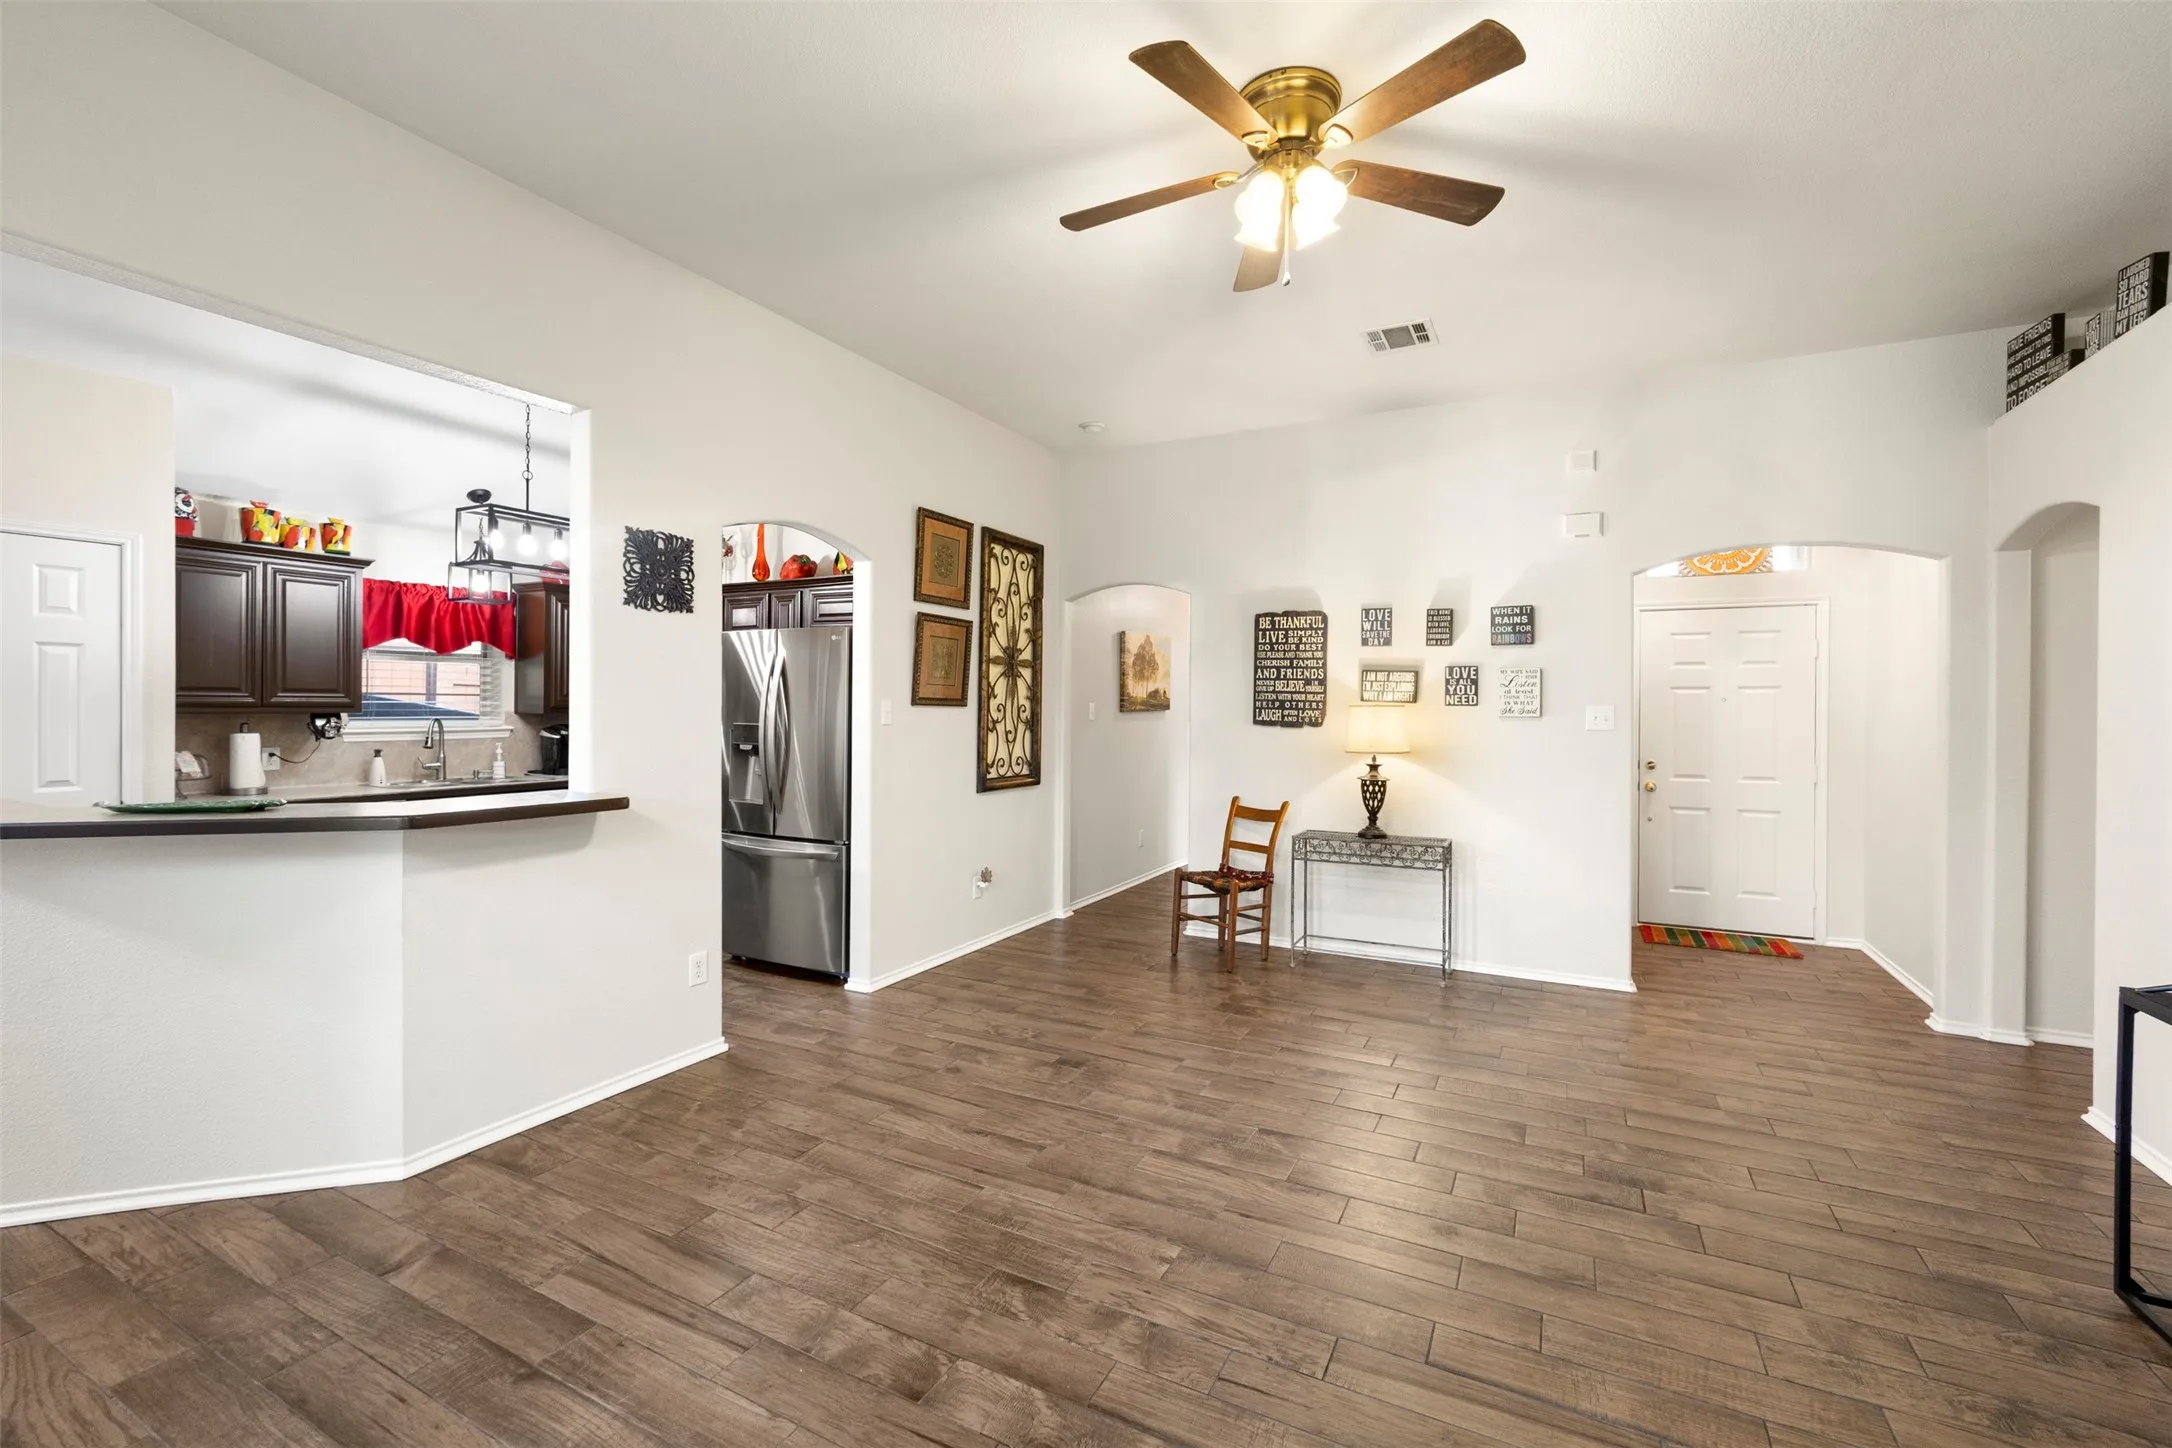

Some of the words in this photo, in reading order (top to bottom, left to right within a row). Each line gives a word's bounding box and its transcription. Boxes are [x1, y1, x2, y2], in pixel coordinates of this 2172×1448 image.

[2118, 279, 2128, 294] SO
[2129, 268, 2149, 288] HARD
[2118, 281, 2149, 310] TEARS
[2115, 318, 2128, 336] MY
[2007, 335, 2024, 354] TRUE
[2024, 317, 2052, 343] FRIENDS
[2007, 363, 2023, 379] HARD
[2023, 357, 2031, 371] TO
[2032, 345, 2051, 365] LEAVE
[2006, 395, 2017, 411] TO
[1362, 609, 1391, 620] LOVE
[1492, 606, 1520, 614] WHEN
[1259, 617, 1272, 628] BE
[1274, 616, 1324, 628] THANKFUL
[1362, 621, 1390, 630] WILL
[1495, 616, 1528, 624] RAINS
[1258, 631, 1286, 642] LIVE
[1362, 630, 1378, 638] SAVE
[1492, 634, 1532, 644] RAINBOWS
[1368, 638, 1384, 646] DAY
[1256, 668, 1277, 678] AND
[1280, 668, 1324, 679] FRIENDS
[1367, 672, 1376, 681] AM
[1377, 672, 1388, 682] NOT
[1446, 666, 1477, 679] LOVE
[1275, 680, 1305, 692] BELIEVE
[1372, 682, 1384, 691] JUST
[1447, 685, 1476, 695] YOU
[1363, 691, 1378, 700] WHY
[1382, 692, 1393, 701] AM
[1394, 692, 1414, 702] RIGHT
[1446, 694, 1477, 705] NEED
[1256, 710, 1282, 720] LAUGH
